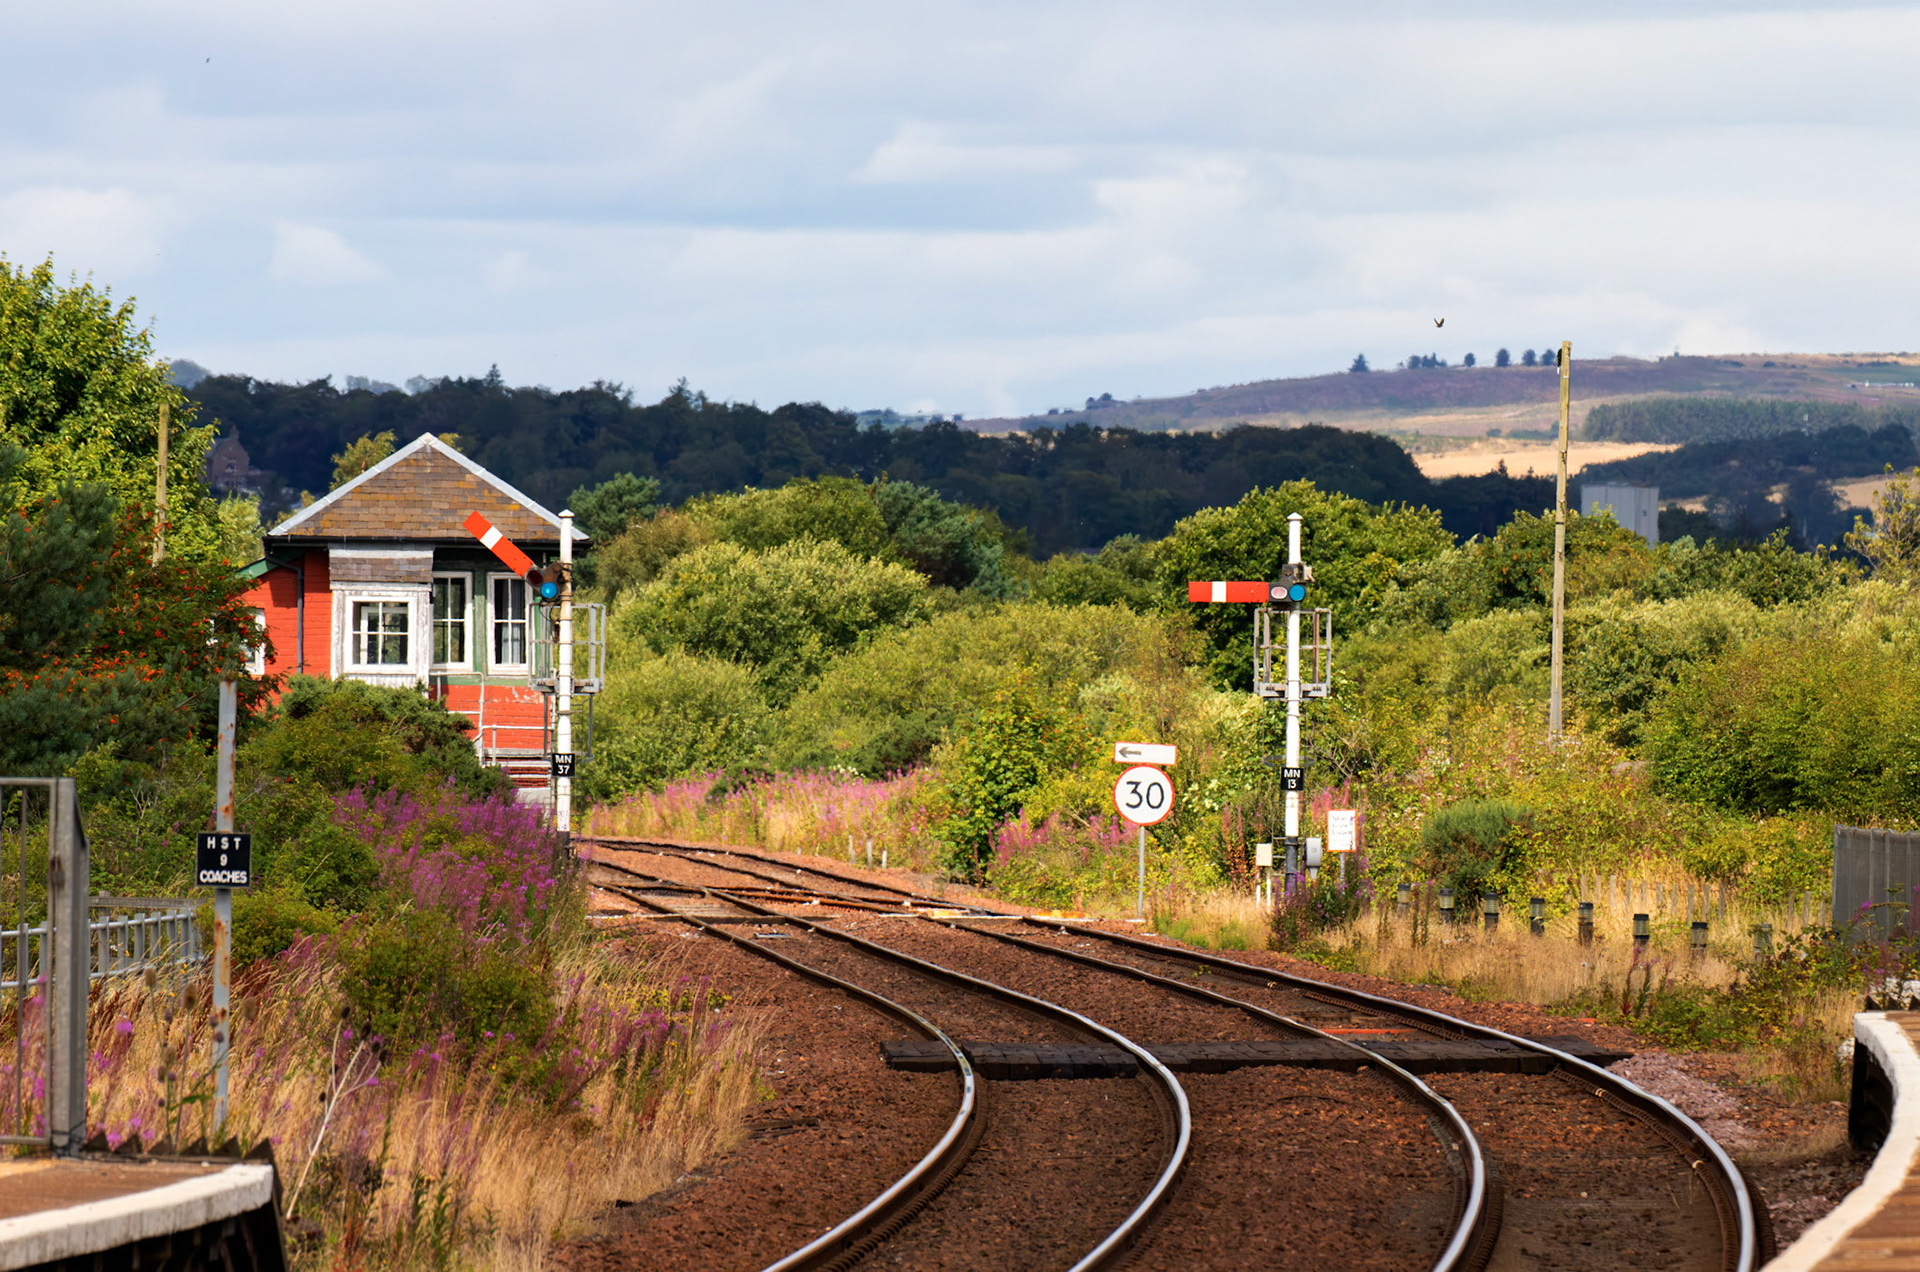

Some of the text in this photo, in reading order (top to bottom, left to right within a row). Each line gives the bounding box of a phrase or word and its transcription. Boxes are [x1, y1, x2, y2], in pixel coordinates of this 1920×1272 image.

[555, 754, 572, 764] MN
[557, 764, 570, 775] 37
[1283, 768, 1300, 778] MN
[1287, 778, 1297, 789] 13
[1125, 780, 1165, 810] 30
[220, 853, 228, 867] 9
[199, 869, 248, 884] COACHES
